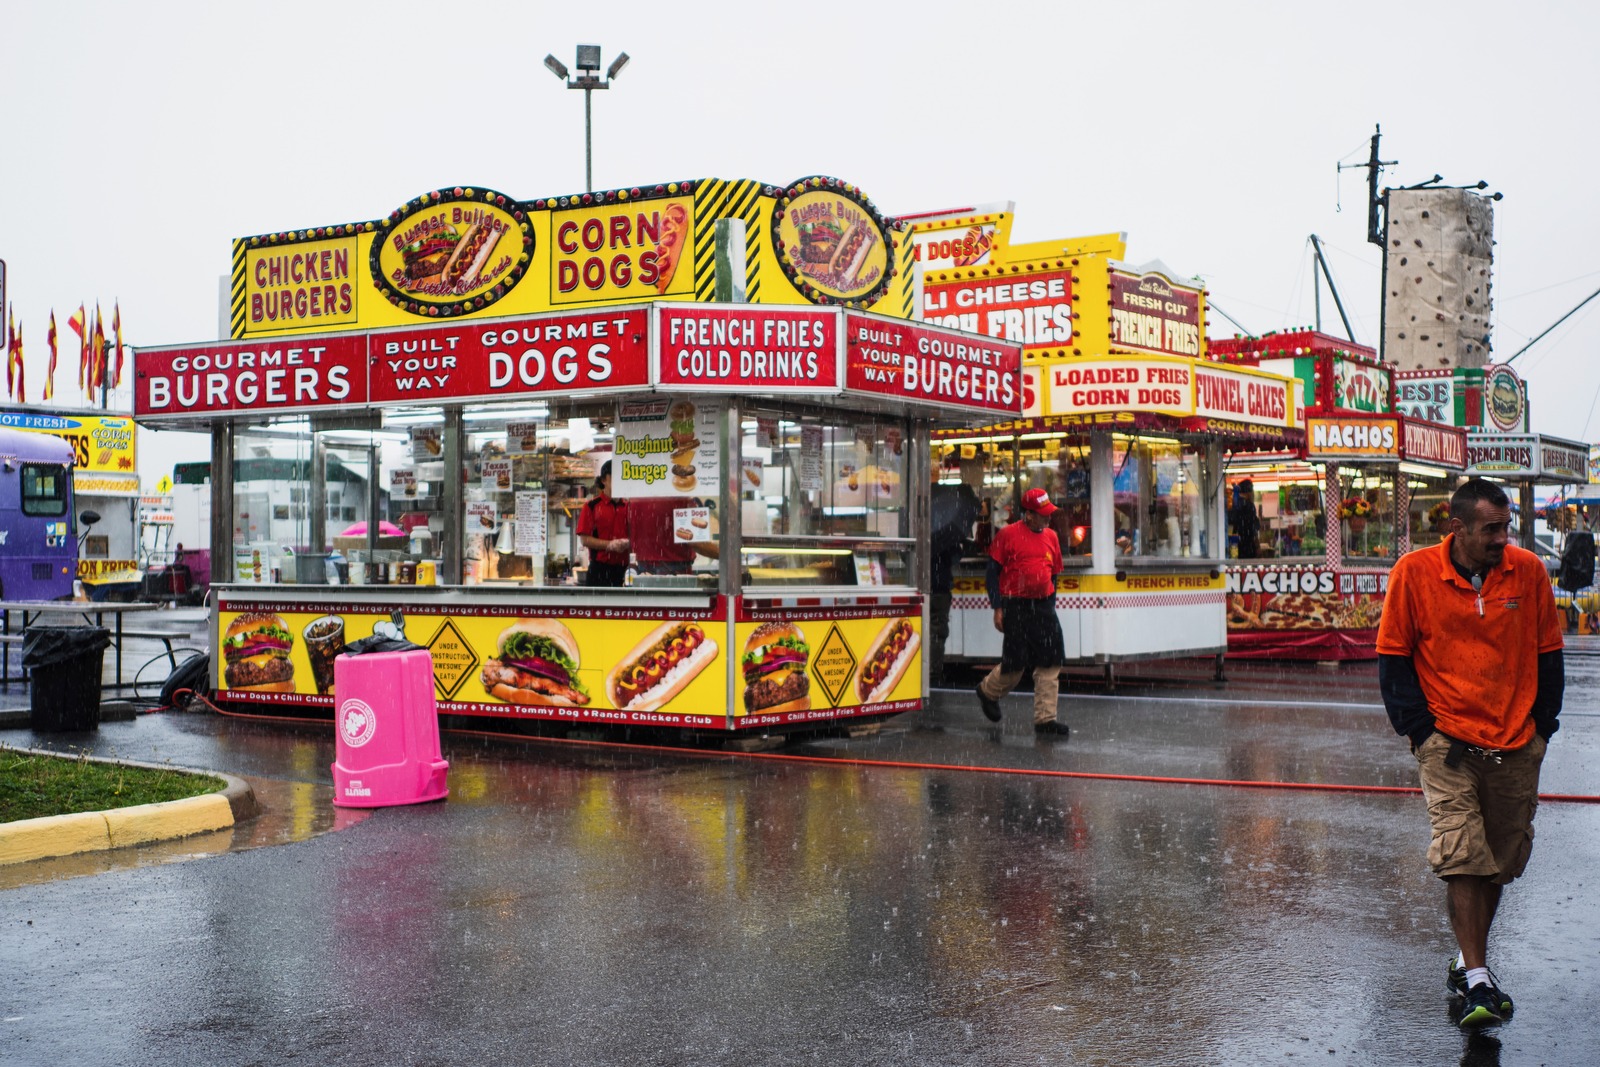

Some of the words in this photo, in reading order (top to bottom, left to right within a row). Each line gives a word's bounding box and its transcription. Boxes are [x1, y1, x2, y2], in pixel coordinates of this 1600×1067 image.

[393, 213, 446, 252] Burger
[453, 207, 510, 236] Builder
[558, 212, 660, 254] CORN
[790, 202, 832, 228] Burger
[836, 201, 878, 243] Builder
[928, 238, 974, 260] DOGS
[255, 248, 349, 288] CHICKEN
[558, 251, 660, 293] DOGS
[416, 278, 453, 296] Little
[956, 278, 1065, 308] CHEESE
[251, 284, 352, 322] BURGERS
[1123, 292, 1162, 312] FRESH
[1164, 301, 1189, 317] CUT
[481, 319, 629, 346] GOURMET
[670, 318, 755, 346] FRENCH
[764, 320, 824, 348] FRIES
[987, 304, 1072, 344] FRIES
[1112, 308, 1162, 349] FRENCH
[1165, 320, 1198, 355] FRIES
[385, 337, 460, 355] BUILT
[859, 327, 902, 346] BUILT
[172, 347, 326, 372] GOURMET
[860, 347, 900, 365] YOUR
[918, 338, 1002, 366] GOURMET
[388, 356, 457, 372] YOUR
[489, 343, 612, 388] DOGS
[677, 350, 731, 378] COLD
[740, 351, 818, 379] DRINKS
[396, 375, 449, 390] WAY
[864, 368, 896, 384] WAY
[904, 355, 1014, 405] BURGERS
[1056, 368, 1139, 387] LOADED
[1147, 368, 1189, 385] FRIES
[150, 366, 350, 409] BURGERS
[1072, 389, 1129, 406] CORN
[1138, 389, 1181, 406] DOGS
[1196, 373, 1244, 415] FUNNEL
[1248, 381, 1286, 421] CAKES
[25, 417, 68, 428] FRESH
[1044, 412, 1136, 427] FRIES
[1207, 418, 1245, 433] CORN
[1249, 425, 1283, 437] DOGS
[92, 428, 131, 440] CORN
[97, 440, 128, 450] DOGS
[1314, 425, 1394, 449] NACHOS
[1405, 425, 1440, 459] PEPPERONI
[1442, 432, 1462, 463] PIZZA
[616, 435, 674, 457] Doughnut
[1468, 447, 1501, 466] FRENCH
[1504, 446, 1531, 468] FRIES
[622, 460, 667, 484] Burger
[1542, 448, 1567, 470] CHEESE
[1568, 452, 1585, 476] STEAK
[1126, 578, 1175, 589] FRENCH
[1178, 576, 1210, 587] FRIES
[1226, 572, 1335, 593] NACHOS
[1340, 574, 1354, 592] PIZZA
[441, 607, 478, 615] Burger
[491, 607, 517, 615] Chili
[522, 607, 564, 616] Cheese
[569, 608, 591, 617] Dog
[605, 609, 663, 618] Barnyard
[669, 610, 712, 619] Burger
[786, 611, 823, 620] Burgers
[833, 610, 868, 618] Chicken
[871, 608, 904, 617] Burgers
[818, 658, 850, 666] CONSTRUCTION
[250, 693, 270, 701] Dogs
[281, 694, 302, 702] Chili
[306, 695, 334, 703] Chees
[436, 702, 467, 710] Burger
[479, 704, 510, 713] Texas
[515, 706, 553, 716] Tommy
[559, 708, 579, 718] Dog
[592, 710, 626, 720] Ranch
[632, 712, 679, 722] Chicken
[684, 715, 712, 724] Club
[761, 715, 780, 725] Dogs
[788, 712, 805, 721] Chili
[807, 710, 834, 720] Cheese
[861, 703, 893, 713] California
[895, 700, 917, 711] Burger
[345, 788, 371, 797] BRUTE
